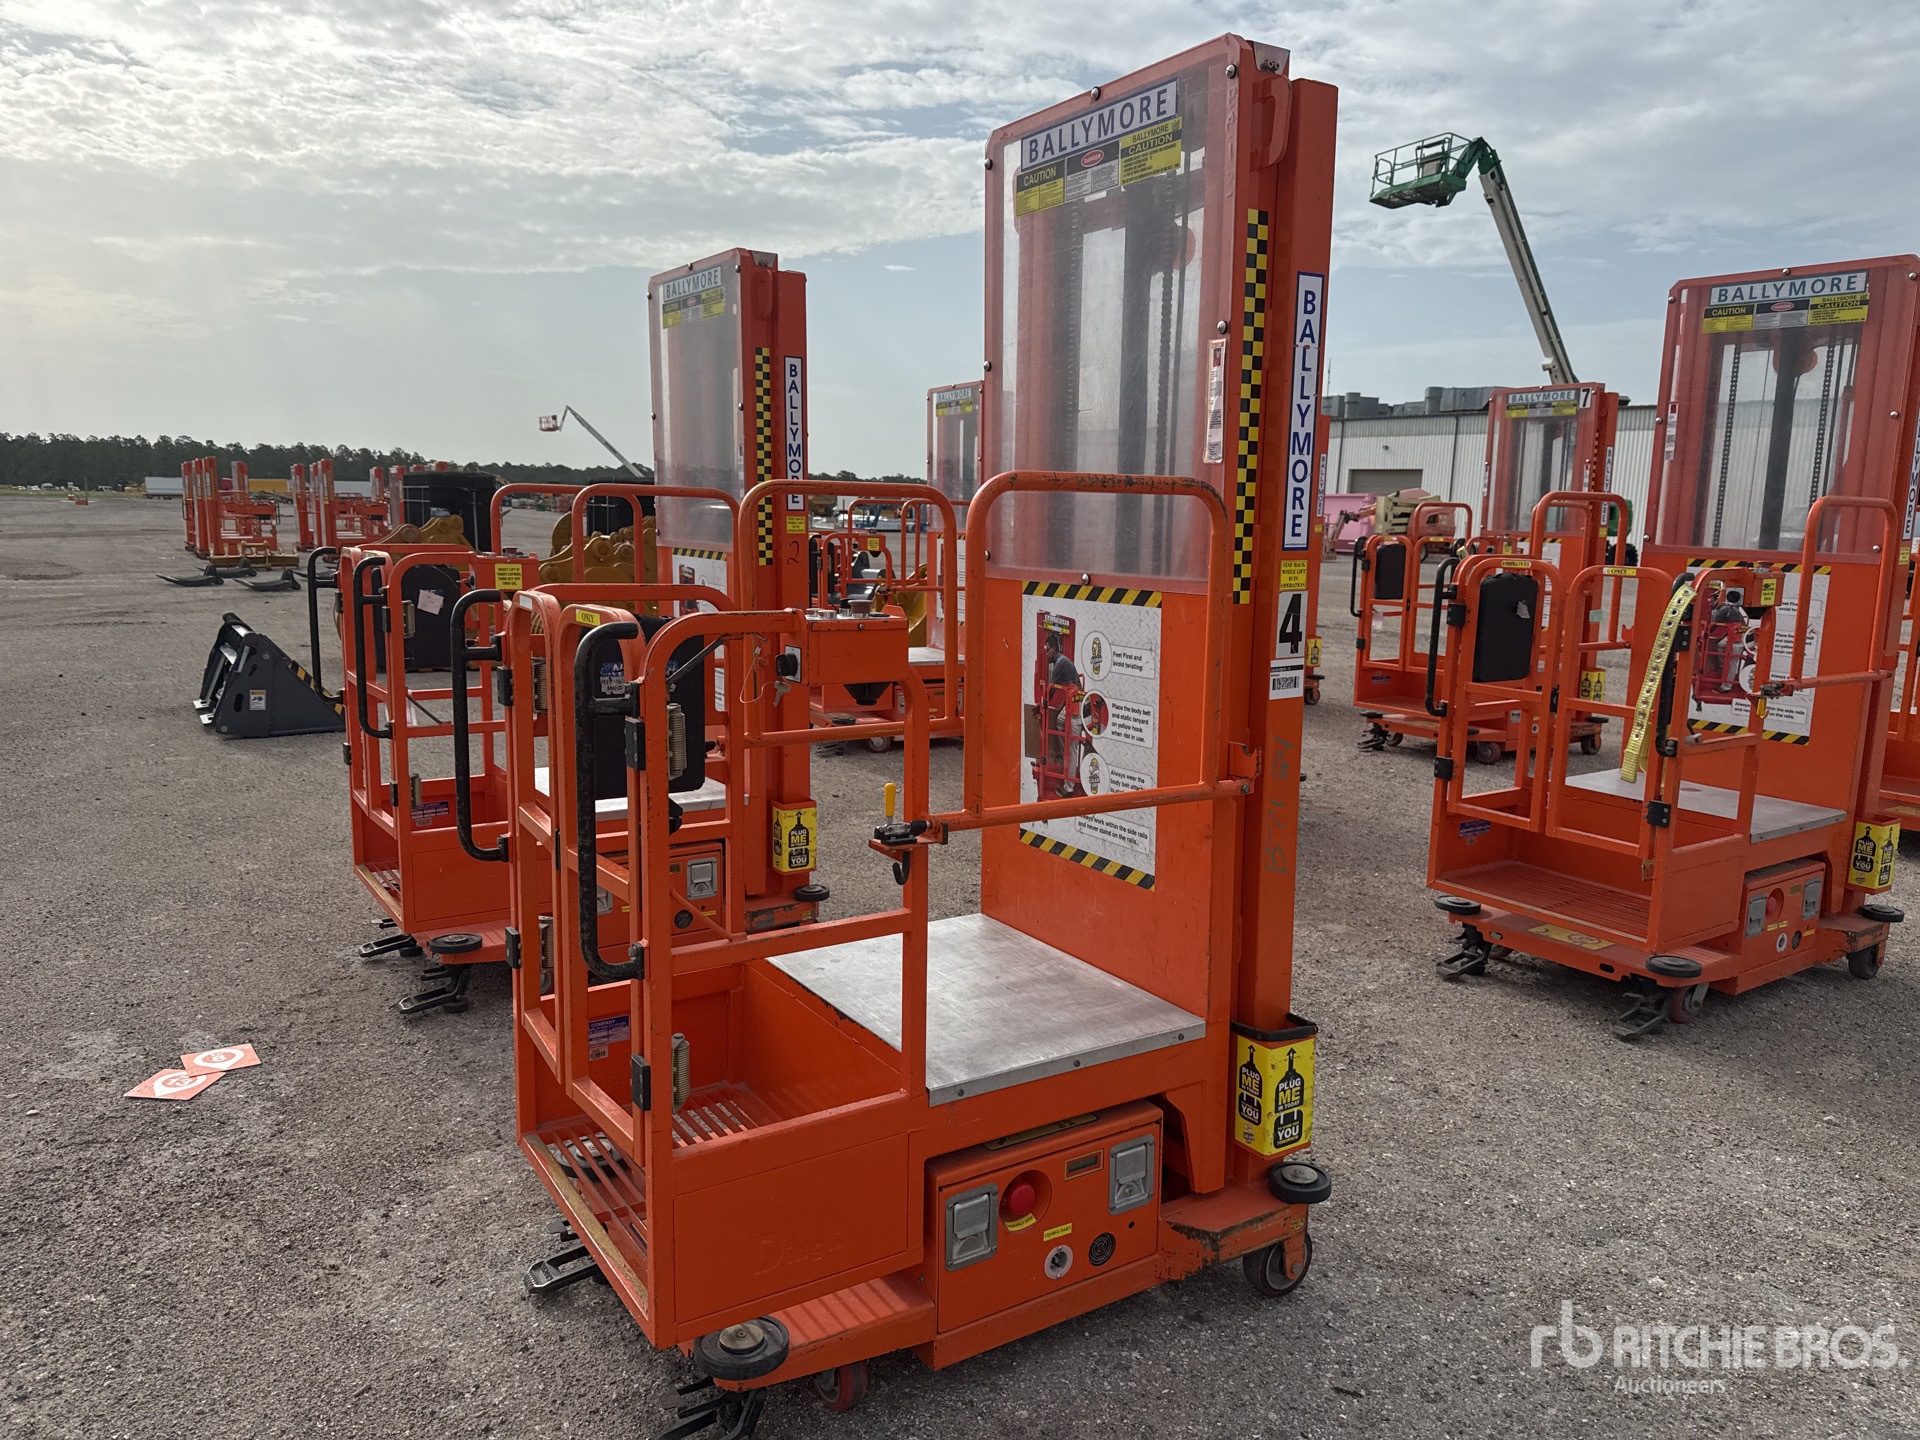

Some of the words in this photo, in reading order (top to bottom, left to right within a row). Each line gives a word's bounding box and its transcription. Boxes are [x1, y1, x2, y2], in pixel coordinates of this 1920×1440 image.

[1029, 88, 1168, 163] BALLYMORE
[1132, 124, 1168, 142] BALLYMORE
[1128, 133, 1172, 154] CAUTION
[1084, 154, 1101, 164] DANGER
[1024, 166, 1056, 187] CAUTION
[666, 269, 718, 298] BALLYMORE
[1718, 274, 1858, 302] BALLYMORE
[1818, 300, 1861, 309] CAUTION
[1712, 308, 1746, 316] CAUTION
[1512, 391, 1572, 402] BALLYMORE
[1582, 388, 1590, 408] 7
[1292, 290, 1316, 538] BALLYMORE
[788, 364, 802, 504] BALLYMOE
[581, 612, 594, 623] ONLY
[1279, 593, 1303, 654] 4
[1131, 707, 1142, 716] body
[1133, 716, 1148, 725] lanyard
[1111, 770, 1126, 779] Always
[1087, 823, 1098, 832] never
[1099, 827, 1111, 836] stand
[1105, 821, 1118, 829] within
[1138, 831, 1148, 839] rails
[791, 835, 807, 843] ME
[1858, 844, 1874, 852] ME
[791, 856, 807, 864] YOU
[1856, 862, 1871, 870] YOU
[590, 1019, 616, 1028] COMPANY
[1242, 1066, 1260, 1080] PLUG
[1242, 1074, 1260, 1091] ME
[1278, 1078, 1301, 1091] PLUG
[1278, 1086, 1300, 1106] ME
[1285, 1101, 1300, 1109] TODAY
[1242, 1105, 1258, 1120] YOU
[1278, 1125, 1299, 1140] YOU
[1045, 1230, 1060, 1238] CHARGE
